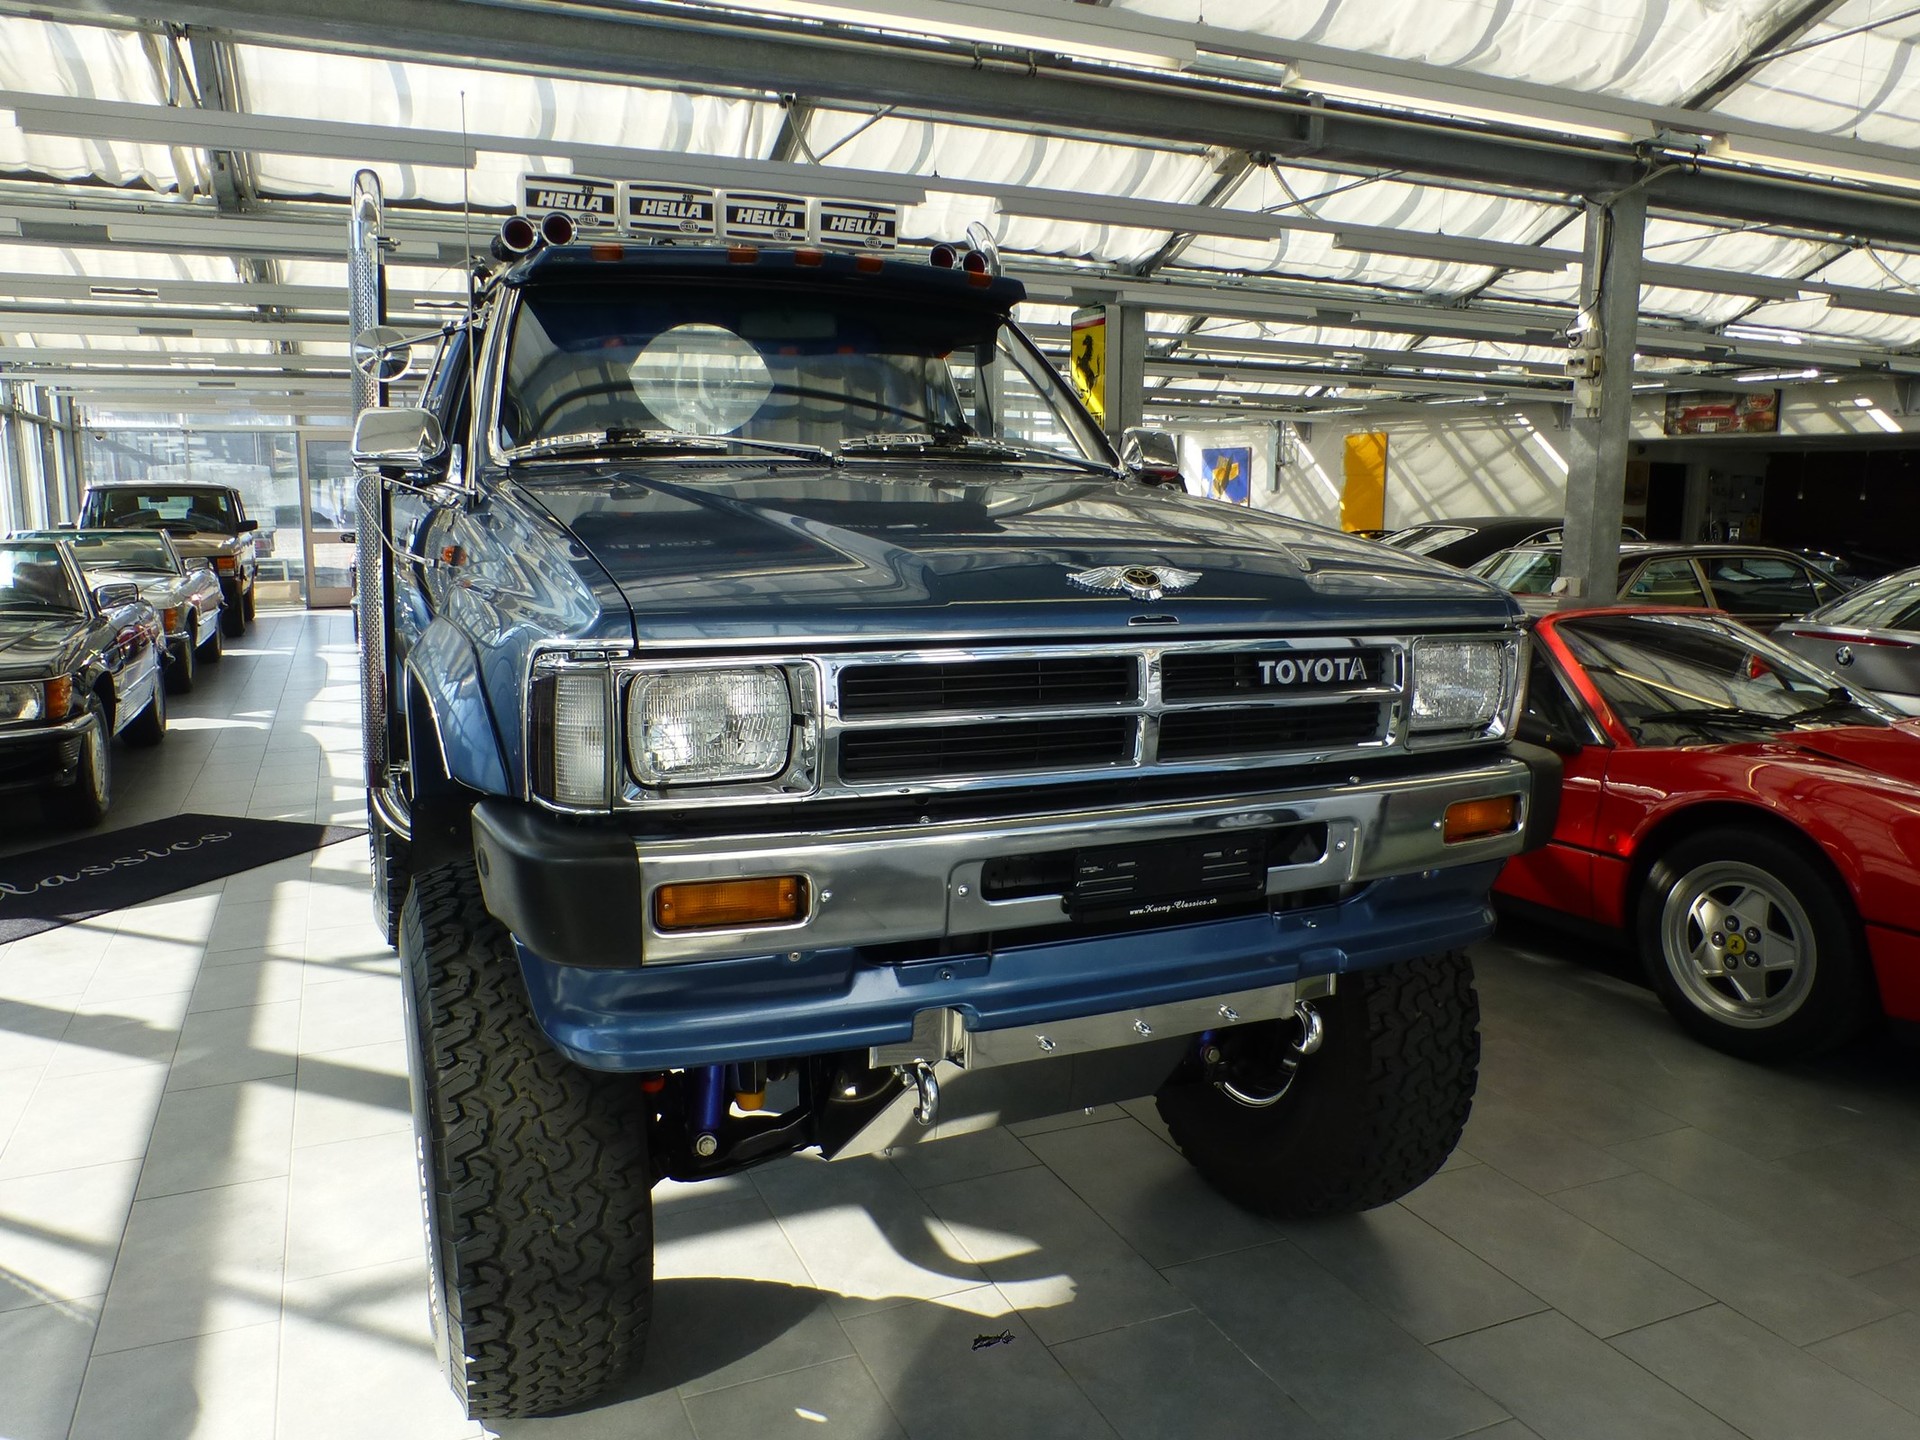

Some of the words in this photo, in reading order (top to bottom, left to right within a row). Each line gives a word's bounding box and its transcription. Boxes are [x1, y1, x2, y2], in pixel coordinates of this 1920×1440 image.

[537, 191, 603, 211] HELLA
[640, 199, 702, 218] HELLA
[736, 208, 795, 227] HELLA
[830, 216, 886, 235] HELLA
[1258, 657, 1367, 685] TOYOTA
[0, 831, 232, 900] lassics
